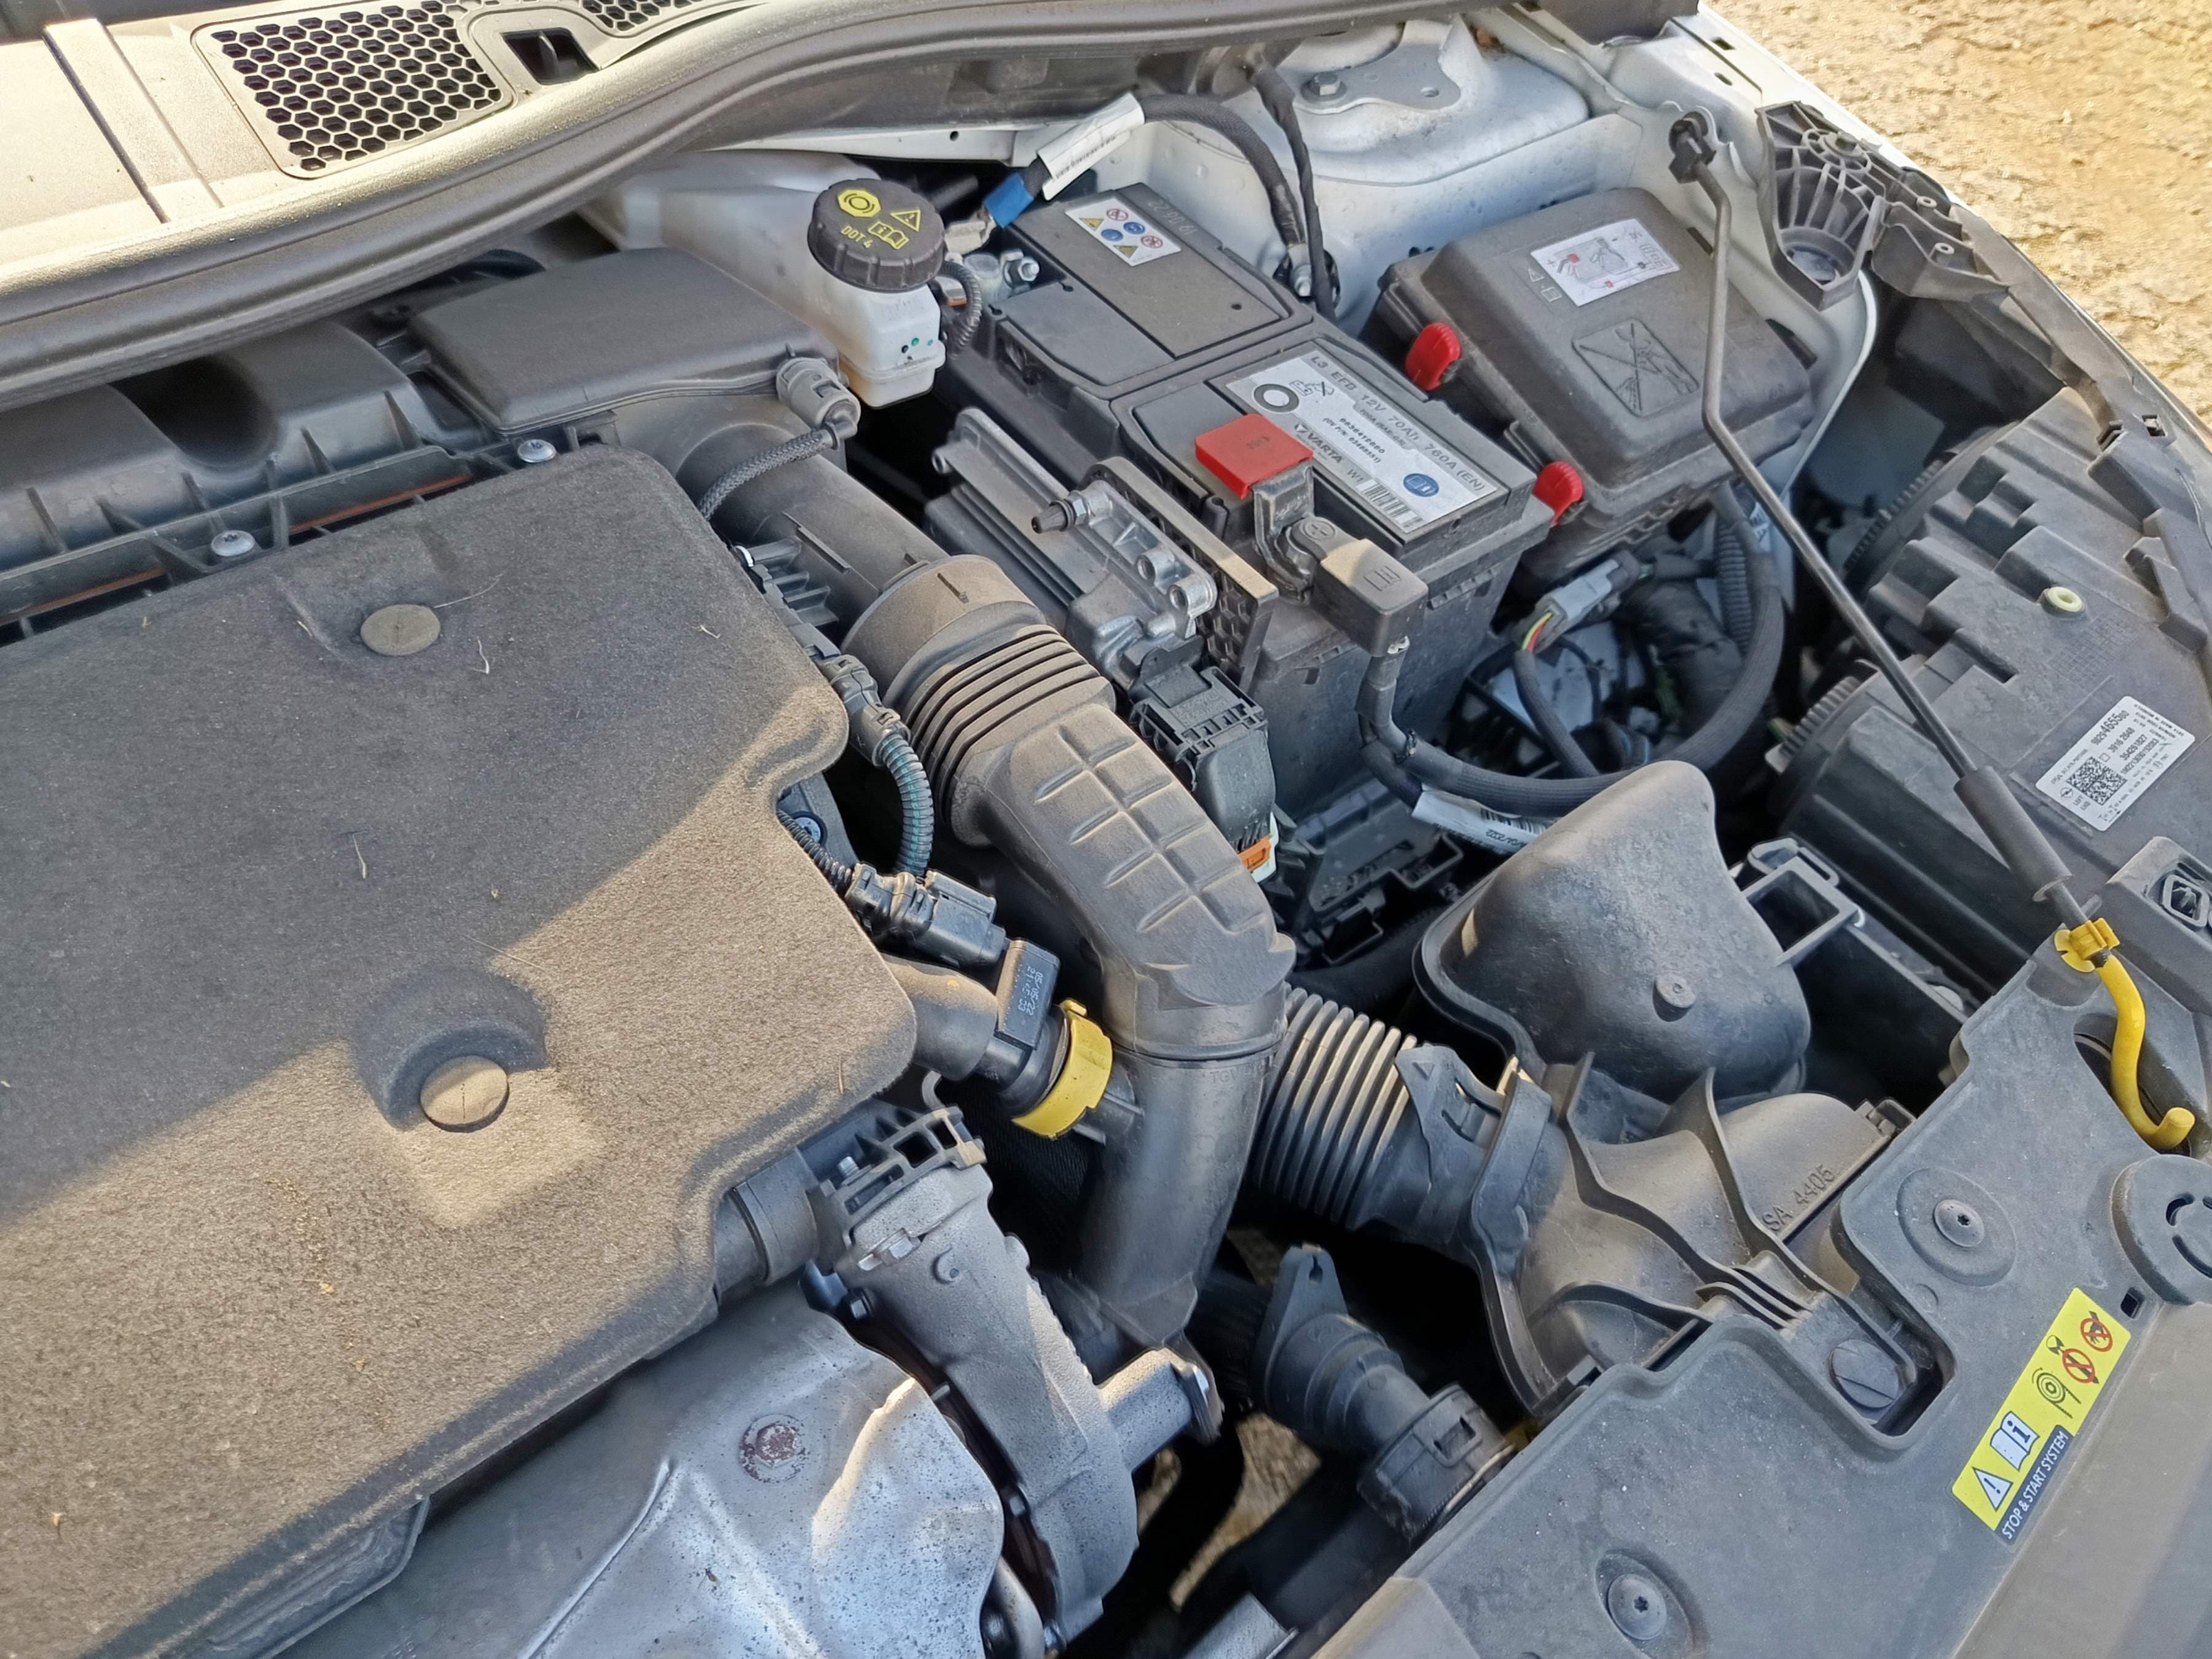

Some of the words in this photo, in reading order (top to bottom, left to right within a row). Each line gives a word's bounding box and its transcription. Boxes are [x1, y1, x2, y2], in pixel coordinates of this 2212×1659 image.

[841, 226, 866, 242] DOT
[863, 240, 873, 248] 4
[1310, 356, 1328, 368] L3
[1331, 371, 1357, 391] EFB
[1361, 394, 1387, 412] 12V
[1388, 415, 1419, 440] 70Ah
[1424, 444, 1457, 469] 760A
[1457, 470, 1485, 491] (EN)
[1308, 433, 1343, 463] VARTA
[1026, 971, 1043, 1016] 05/05/22
[1762, 1206, 1794, 1232] SA
[1793, 1164, 1835, 1204] 4405
[2041, 1430, 2069, 1471] SYSTEM
[2023, 1467, 2047, 1502] START
[2002, 1508, 2023, 1539] STOP
[2018, 1500, 2030, 1512] &
